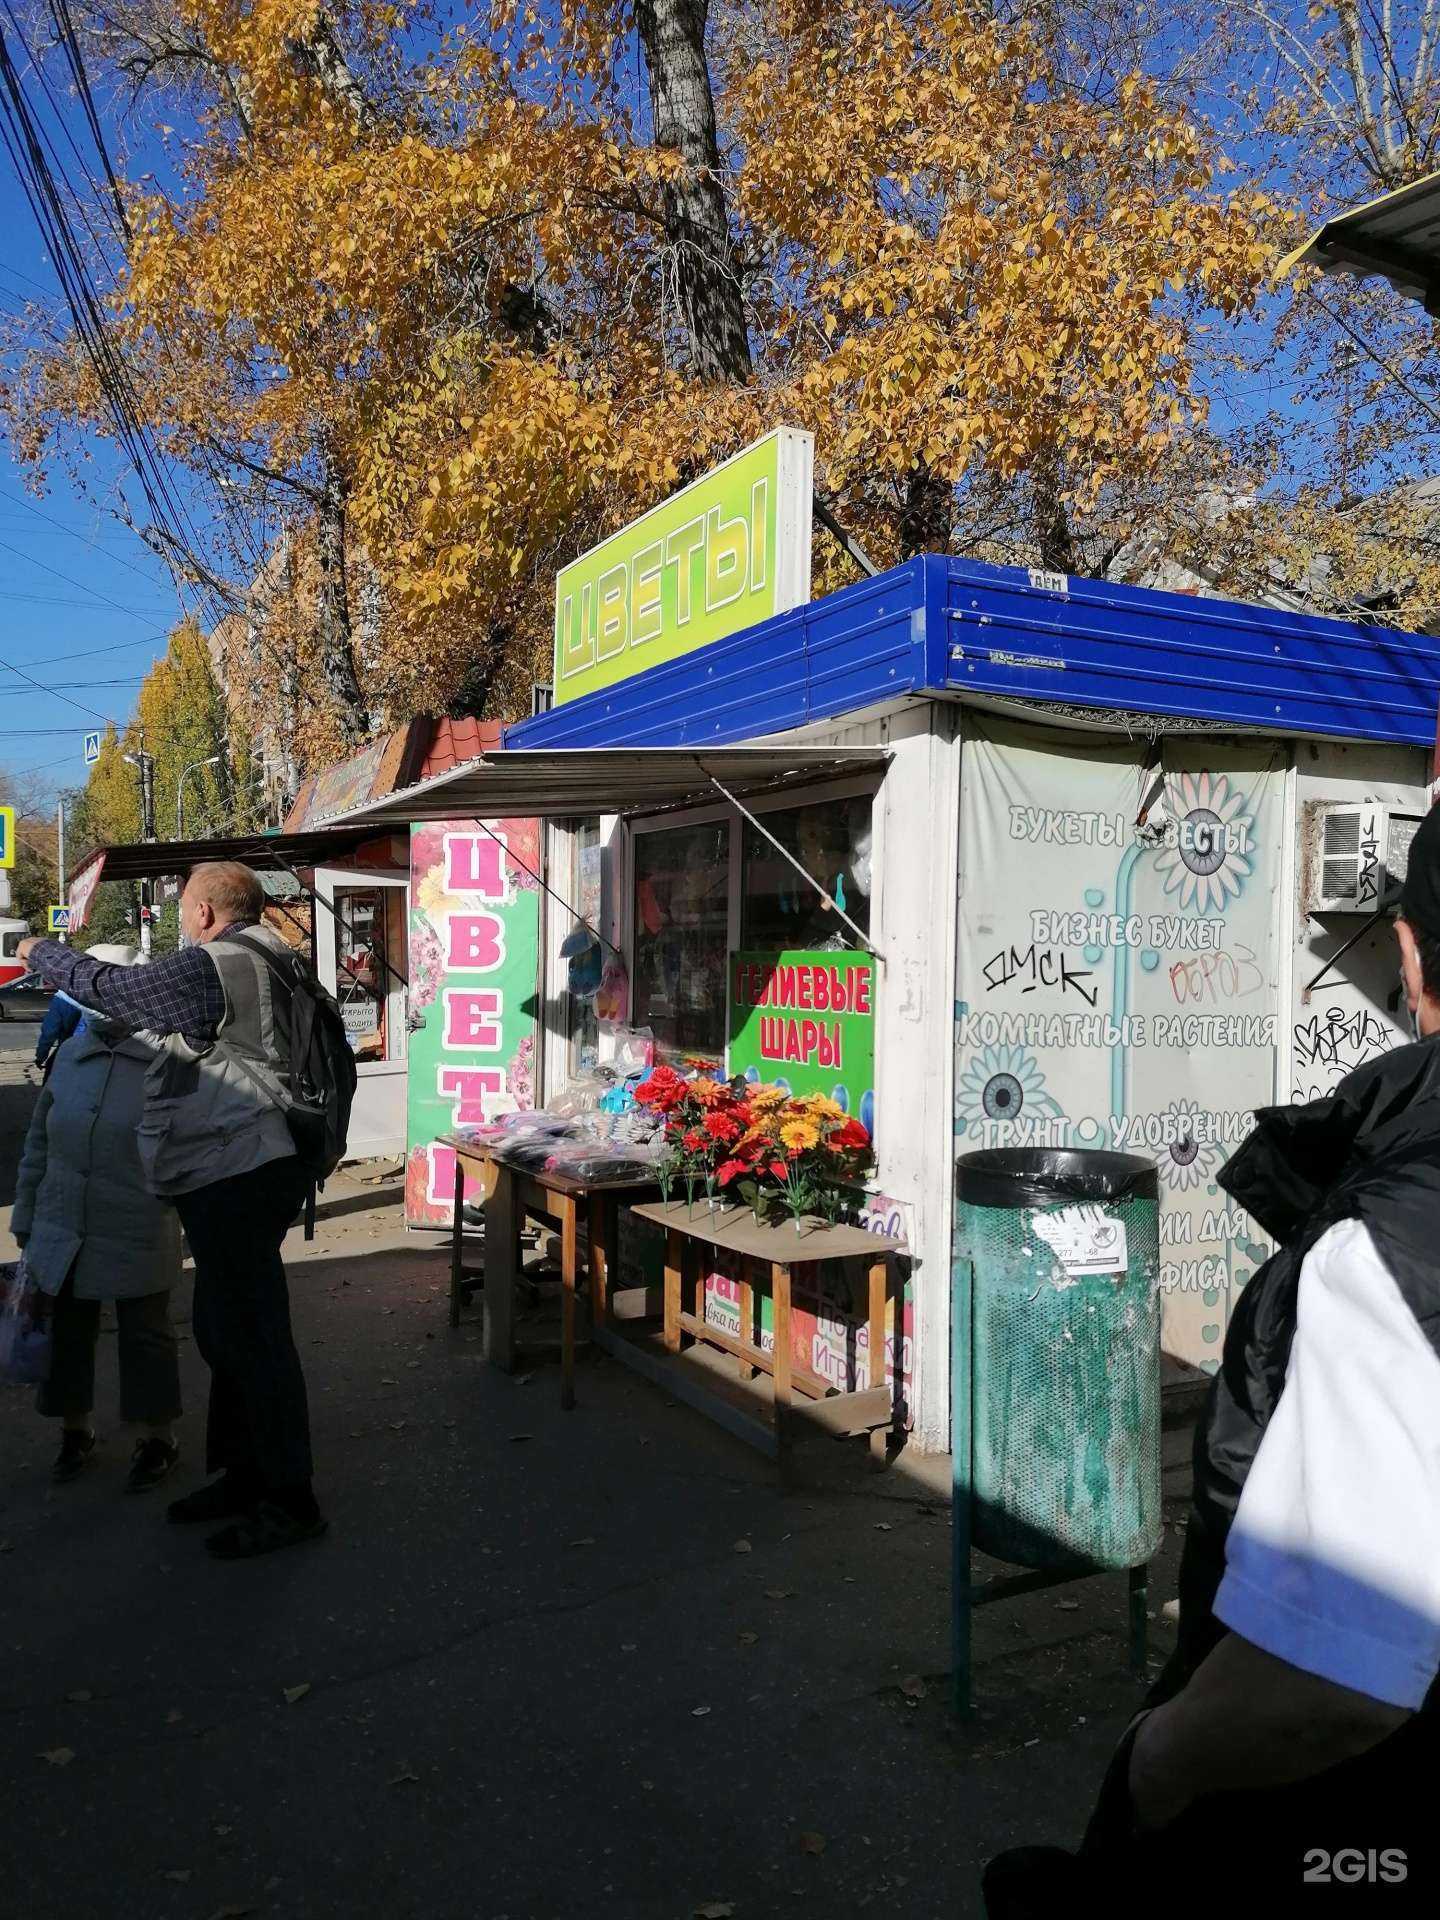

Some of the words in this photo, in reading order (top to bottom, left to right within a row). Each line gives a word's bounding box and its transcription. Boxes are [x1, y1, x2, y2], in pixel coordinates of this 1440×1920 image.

[561, 477, 768, 680] ЦВЕТЫ
[1009, 805, 1125, 848] БУКЕТЫ
[1029, 909, 1143, 947] БИЗНЕС
[1149, 915, 1226, 950] БУКЕТ
[735, 961, 872, 1016] ГЕЛИЕВЫЕ
[760, 1016, 842, 1070] ШАРЫ
[957, 1011, 1146, 1048] КОМНАТНЫЕ
[1153, 1013, 1279, 1048] РАСТЕНИЯ
[981, 1115, 1071, 1149] ГРУНТ
[1109, 1110, 1259, 1149] УДОБРЕНИЯ
[1198, 1207, 1250, 1243] ДЛЯ
